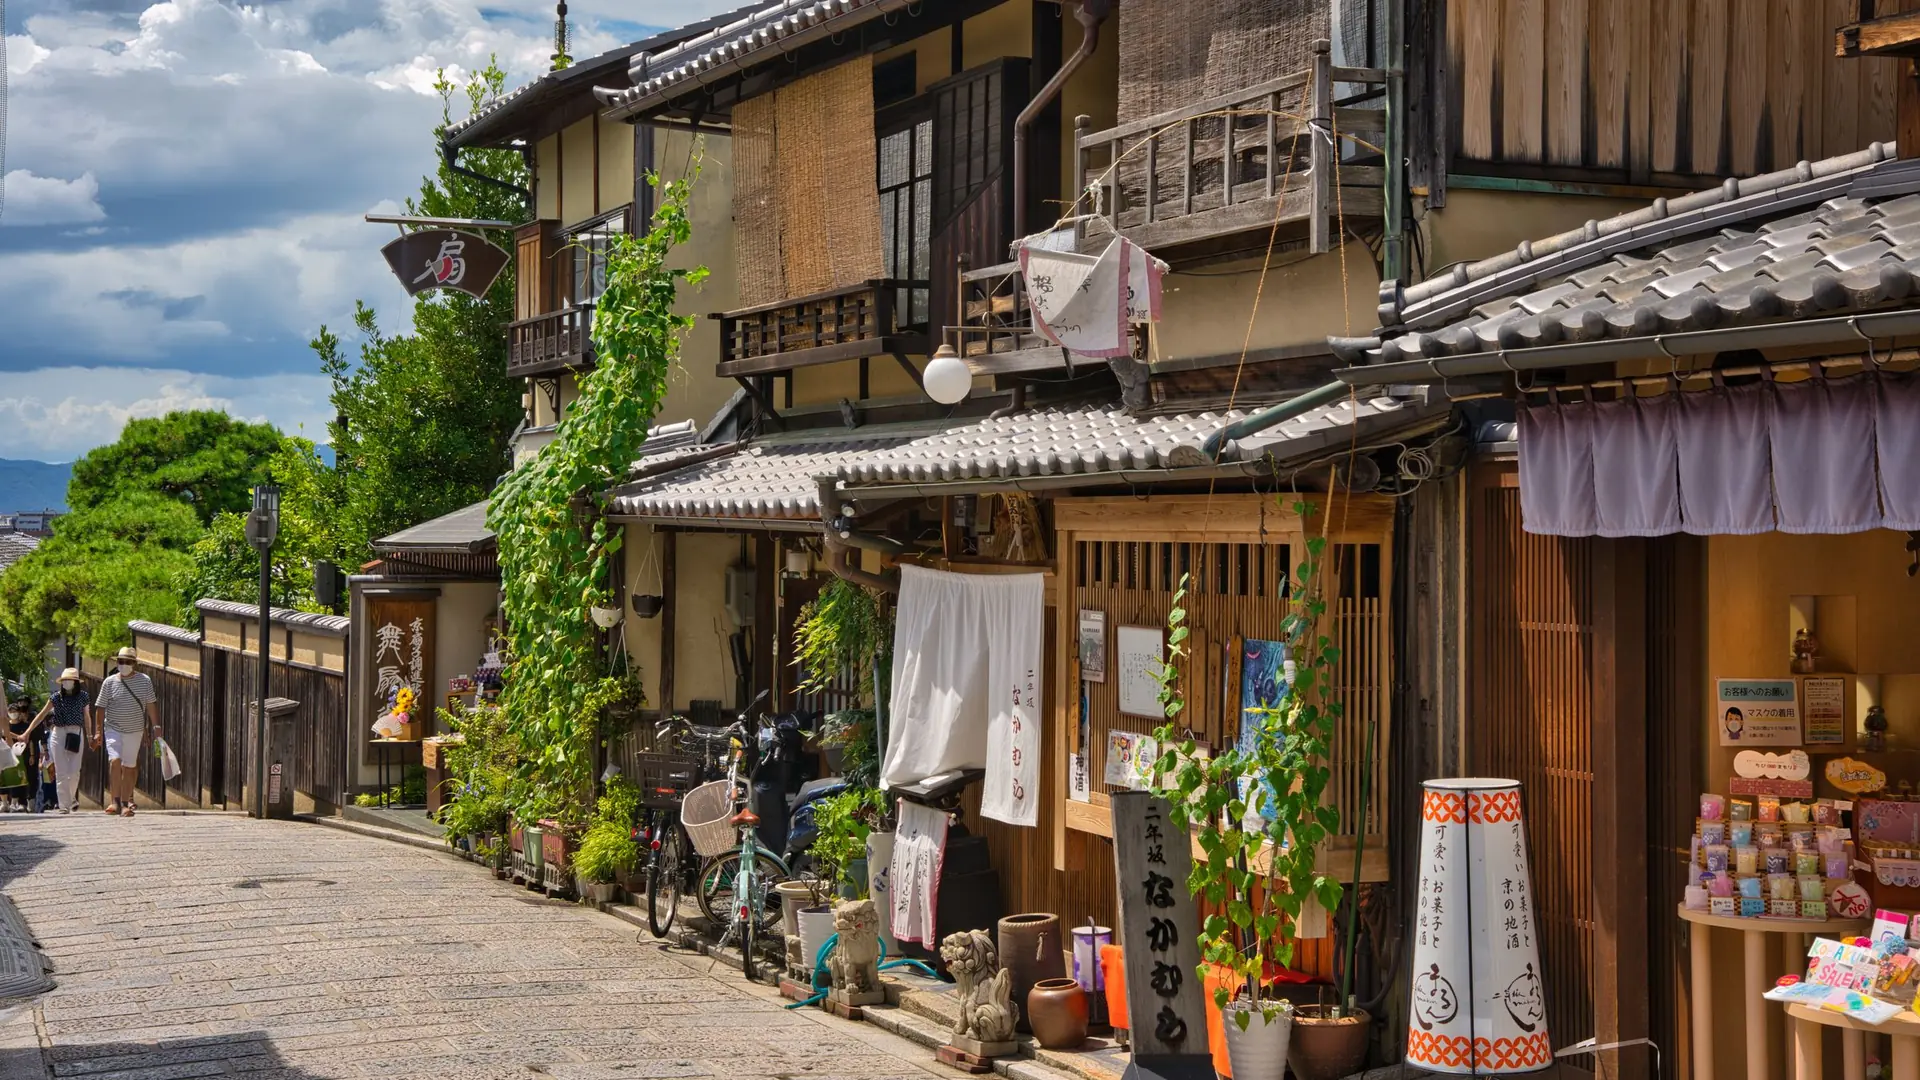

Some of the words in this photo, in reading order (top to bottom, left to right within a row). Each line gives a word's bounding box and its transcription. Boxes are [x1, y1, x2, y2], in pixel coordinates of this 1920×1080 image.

[1723, 687, 1789, 697] お客様へのお願い
[1747, 708, 1795, 718] マスクの着用
[1012, 684, 1025, 801] なかむら
[1144, 806, 1166, 865] 二年坂
[1419, 876, 1429, 946] 京の地酒
[1431, 824, 1447, 949] 可愛いお菓子と
[1501, 878, 1520, 949] 京の地酒
[1512, 823, 1530, 948] 可愛いお菓子と
[1848, 898, 1869, 916] NO!
[1142, 871, 1187, 1044] なかむら
[1818, 964, 1854, 988] SALE
